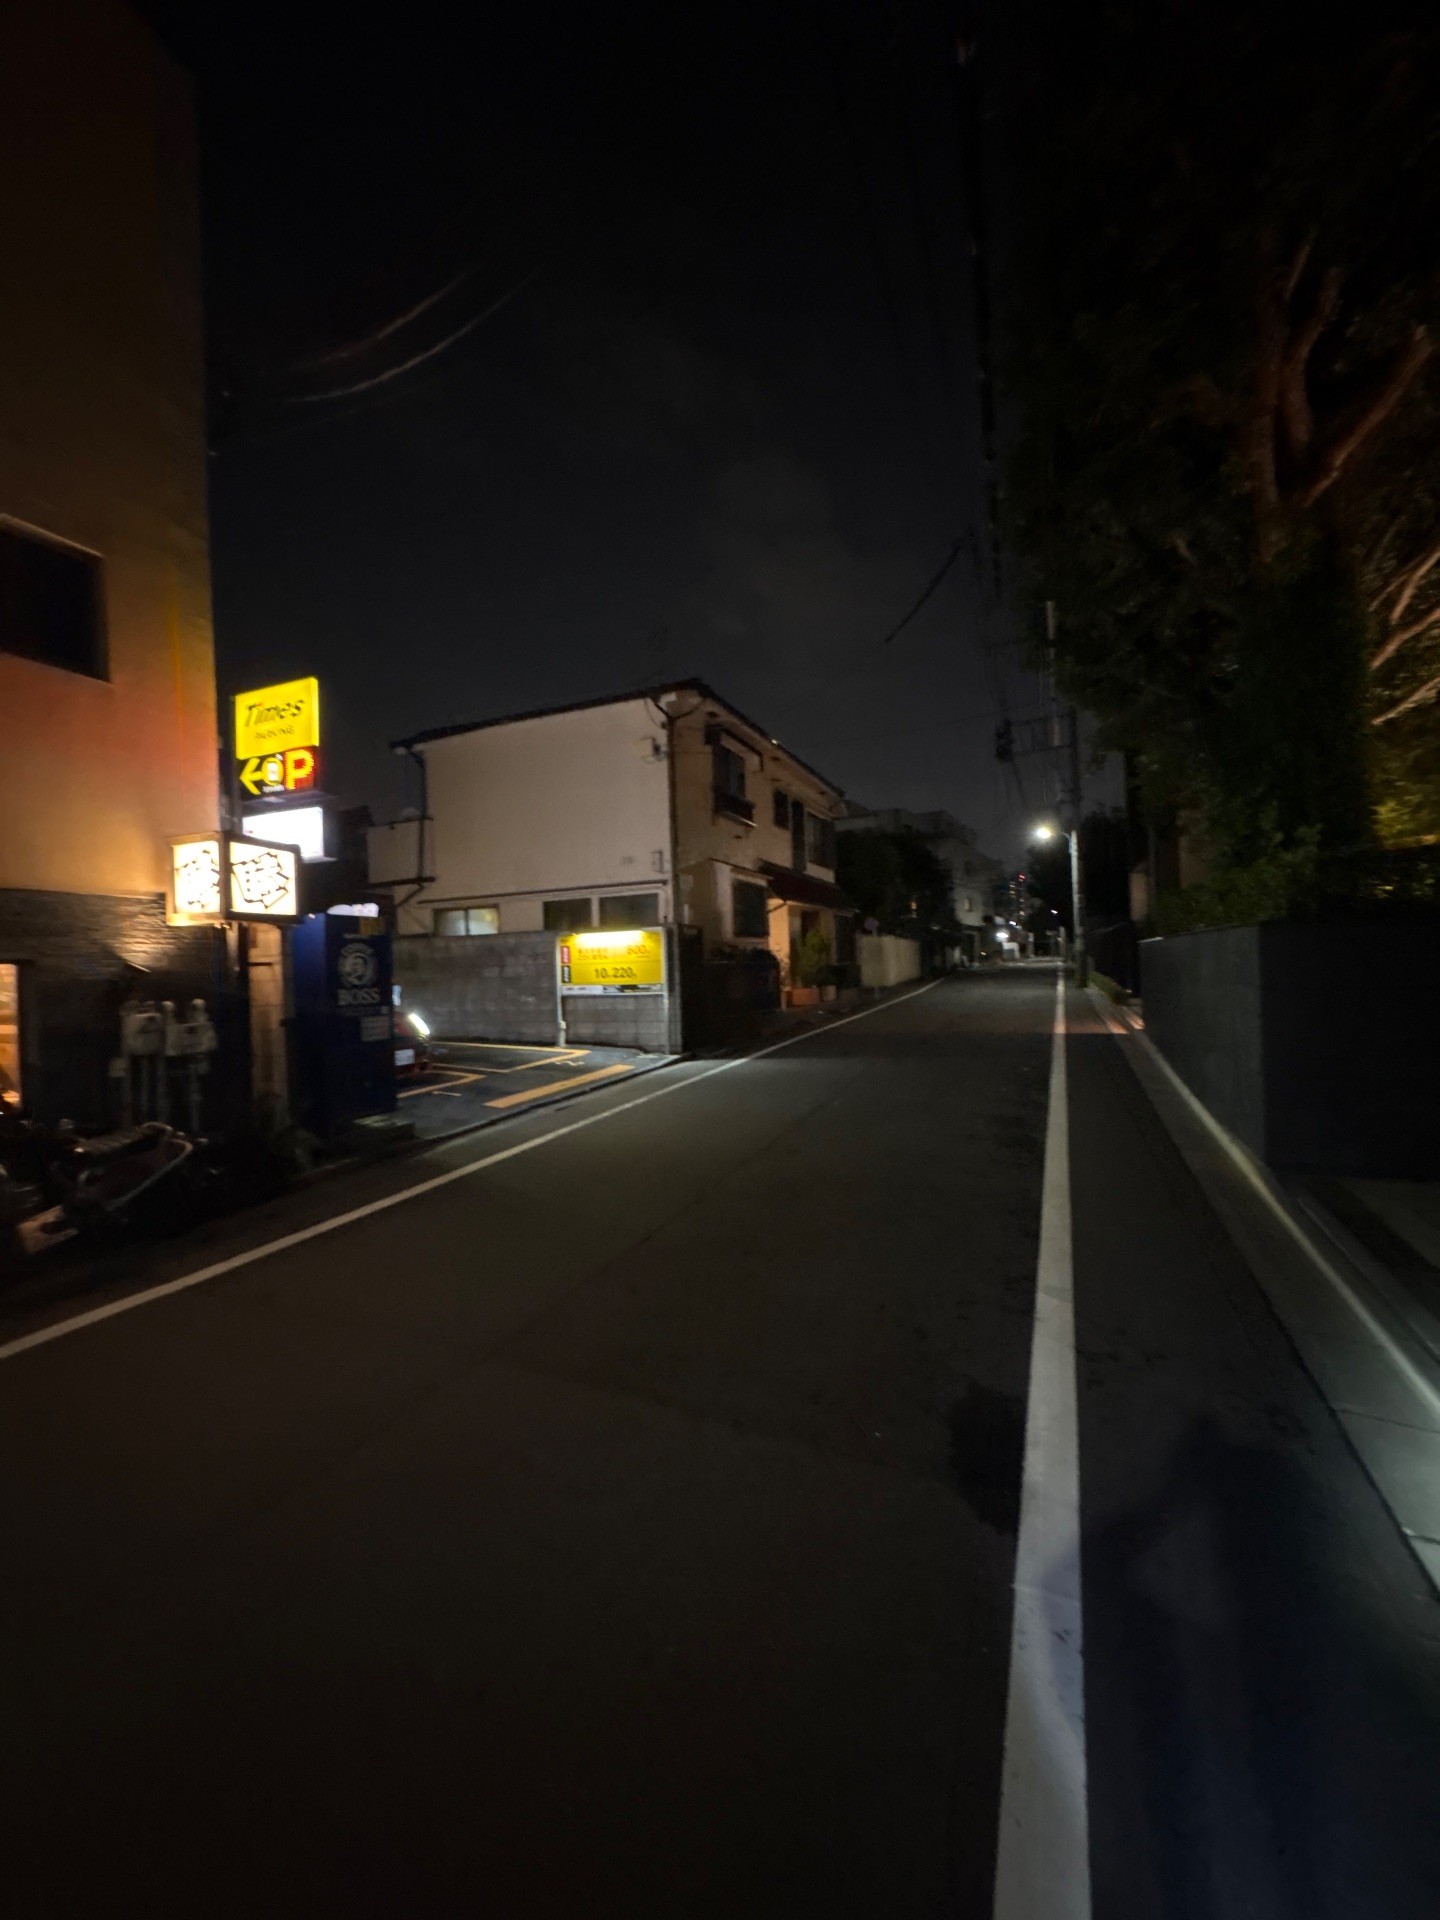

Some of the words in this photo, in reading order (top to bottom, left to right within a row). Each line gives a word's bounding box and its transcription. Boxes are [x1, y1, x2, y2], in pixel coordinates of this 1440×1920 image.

[245, 699, 306, 727] Times
[285, 749, 315, 790] P
[336, 987, 381, 1006] BOSS
